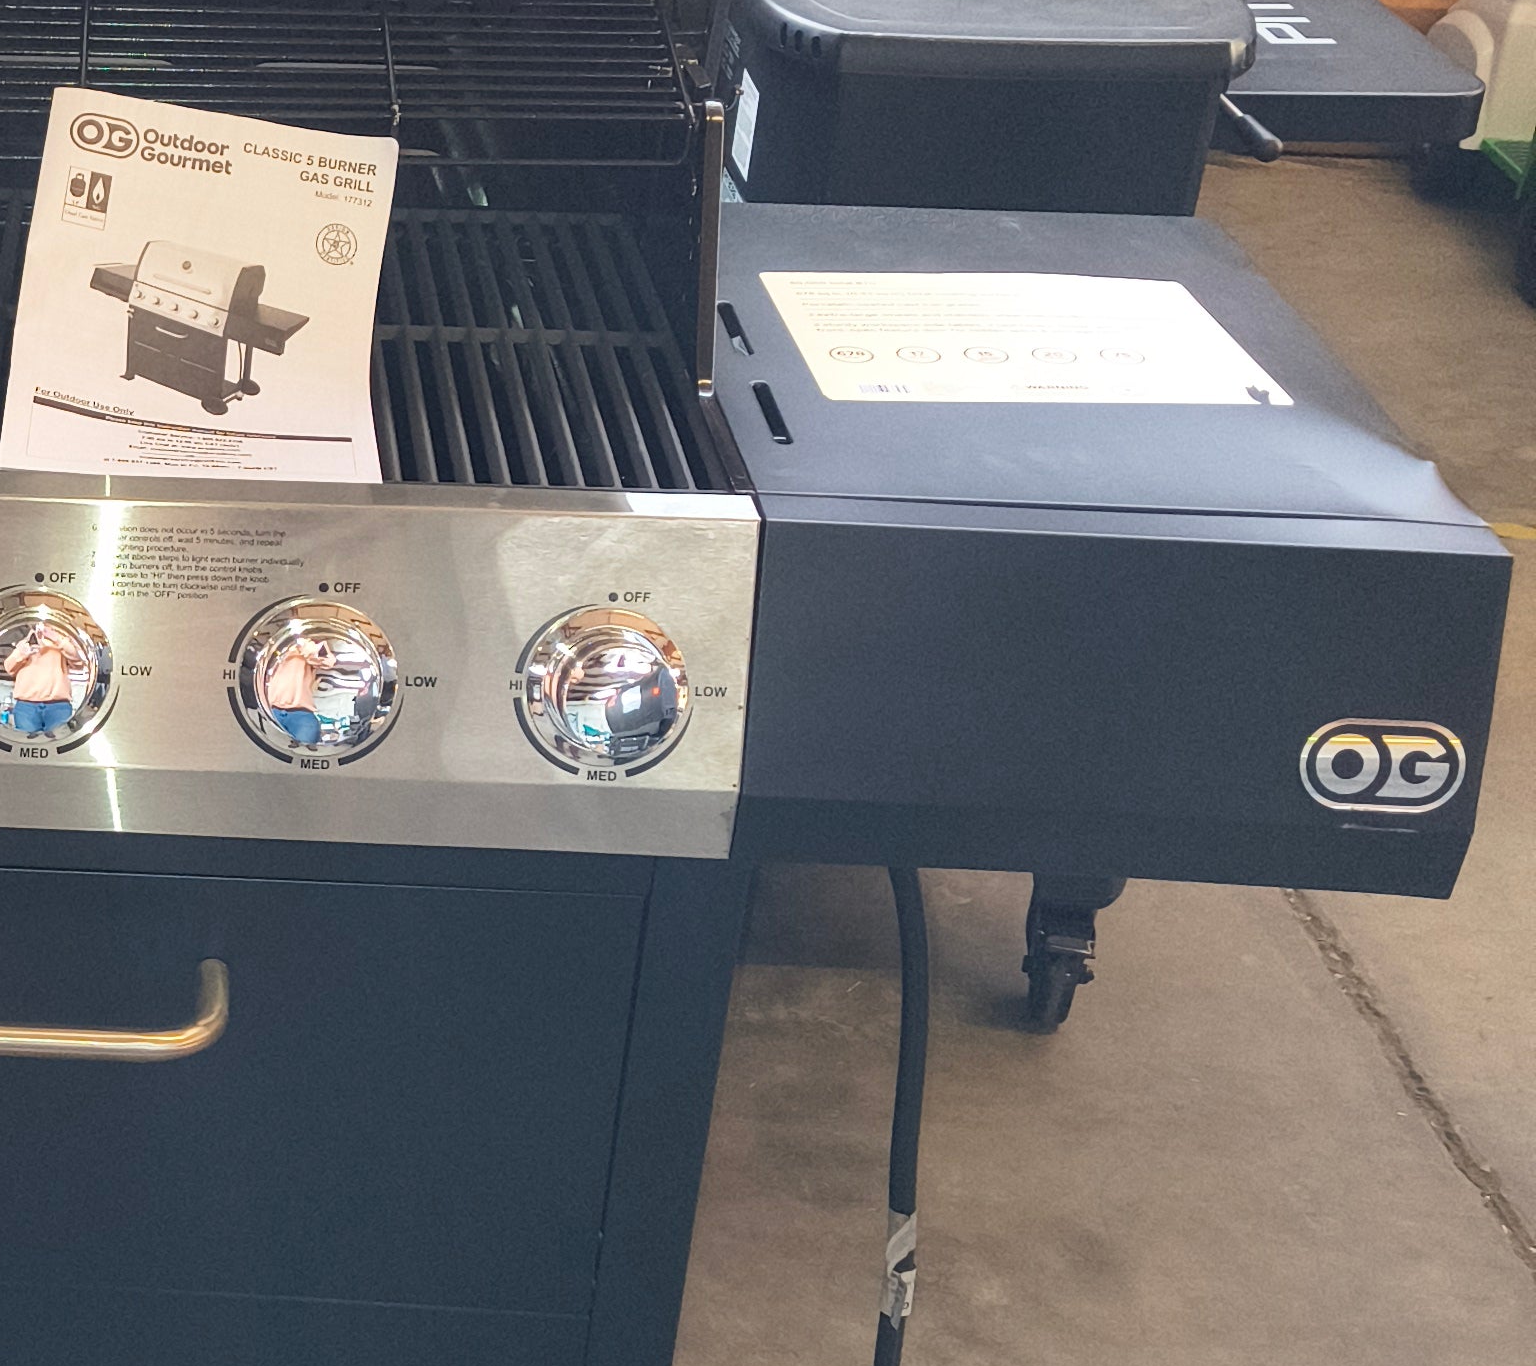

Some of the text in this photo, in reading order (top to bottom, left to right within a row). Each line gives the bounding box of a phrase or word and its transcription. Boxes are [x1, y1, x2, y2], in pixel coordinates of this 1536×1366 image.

[73, 116, 230, 156] OG Outdoor
[140, 146, 233, 176] Gourmet
[243, 142, 378, 177] CLASSIC 5 BURNER
[299, 170, 375, 194] GAS GRILL
[48, 571, 76, 584] OFF
[333, 581, 361, 594] OFF
[623, 591, 652, 603] OFF
[120, 665, 153, 677] LOW
[222, 669, 236, 681] HI
[405, 676, 438, 688] LOW
[509, 680, 523, 691] HI
[694, 686, 728, 698] LOW
[19, 746, 50, 759] MED
[300, 758, 331, 771] MED
[1310, 727, 1456, 804] OG
[586, 770, 618, 783] MED
